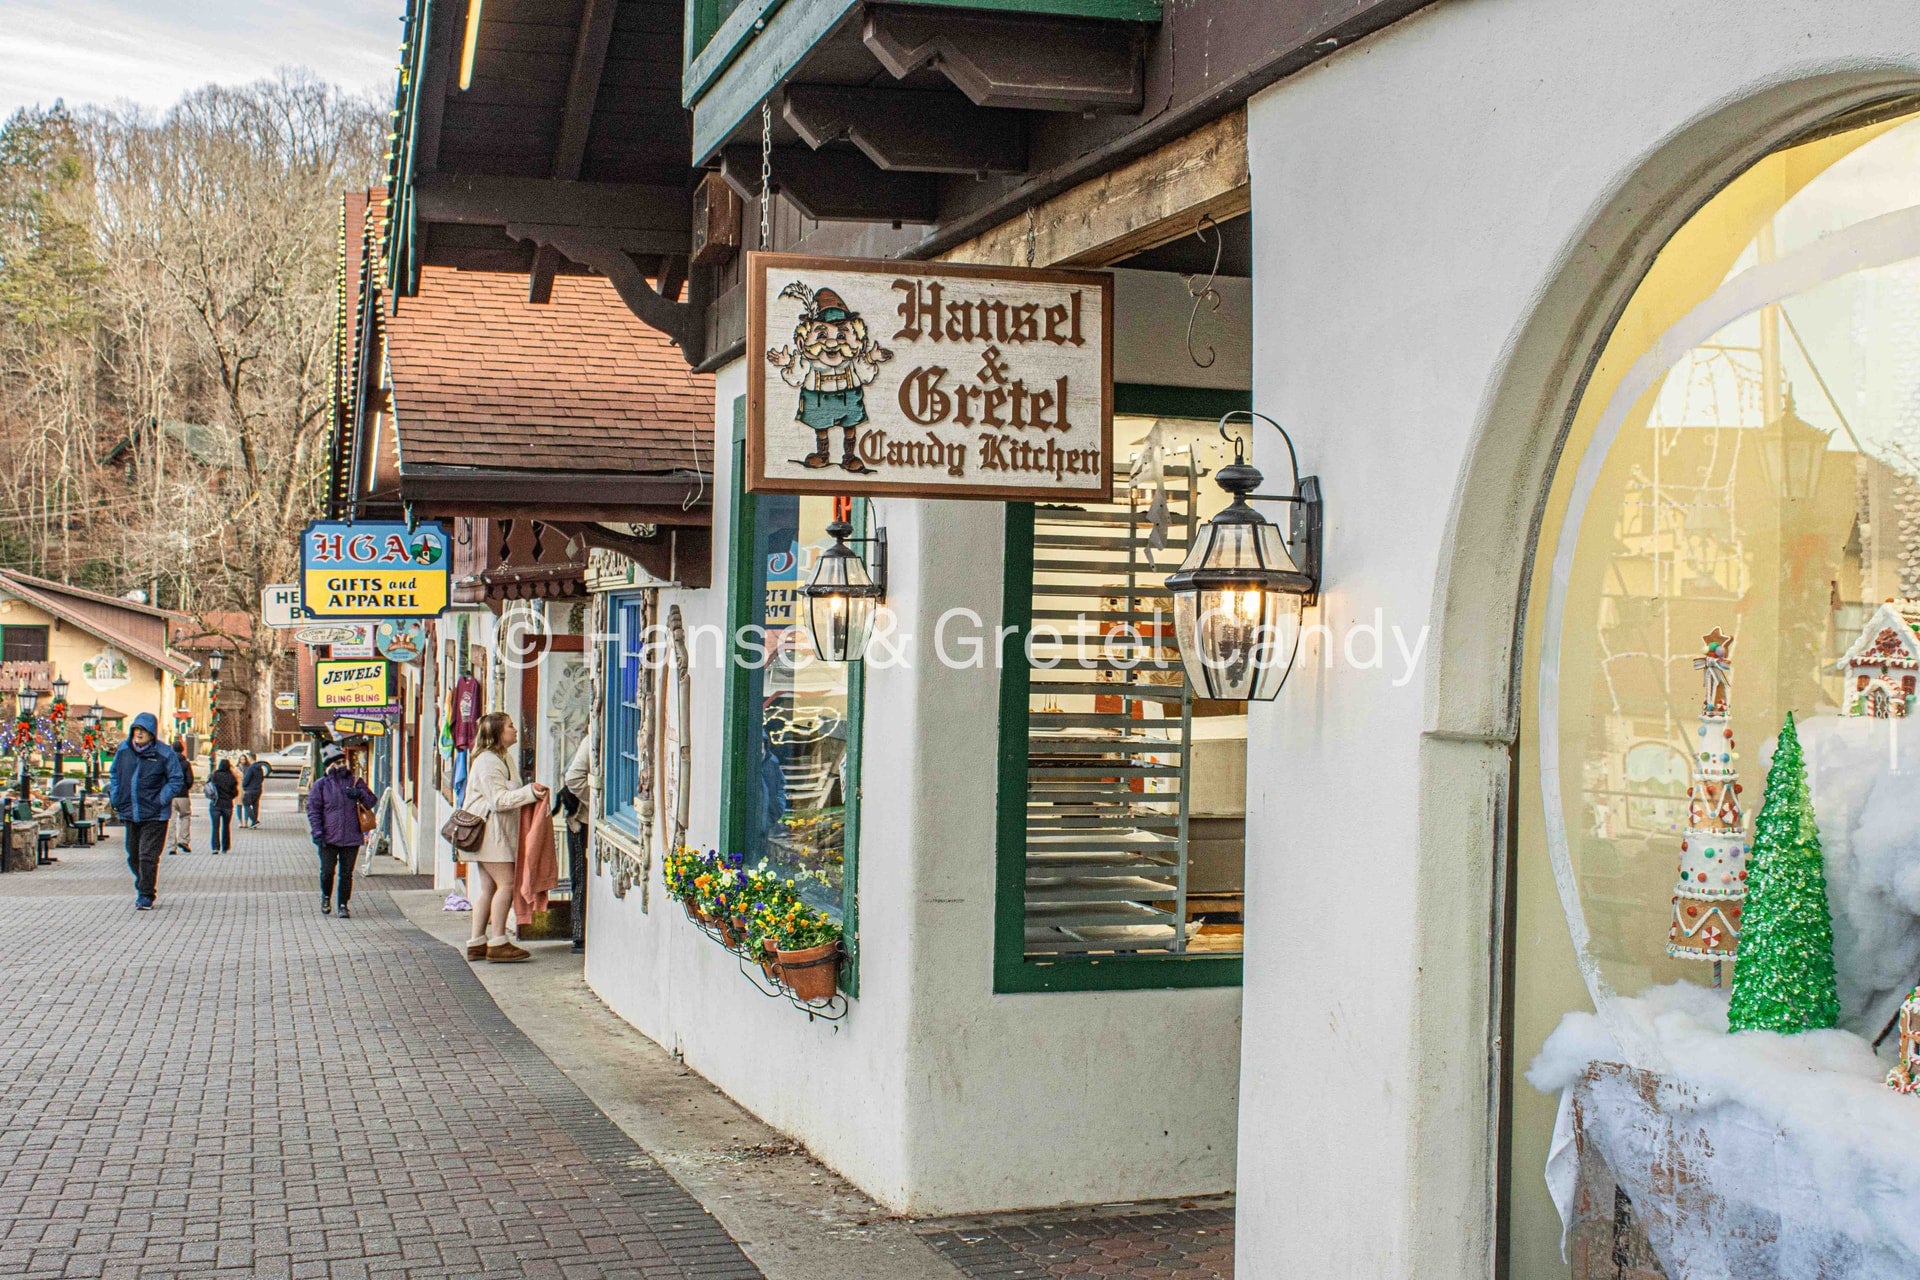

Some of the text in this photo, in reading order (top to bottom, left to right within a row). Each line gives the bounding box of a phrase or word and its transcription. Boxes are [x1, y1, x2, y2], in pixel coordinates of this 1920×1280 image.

[891, 279, 1087, 347] Hansel
[977, 345, 1009, 385] &
[898, 365, 1072, 433] Gretel
[858, 429, 1101, 481] Candy Kitchen
[312, 533, 412, 563] HGA
[327, 577, 417, 591] GIFTS and
[328, 594, 419, 607] APPAREL
[323, 665, 382, 685] JEWELS
